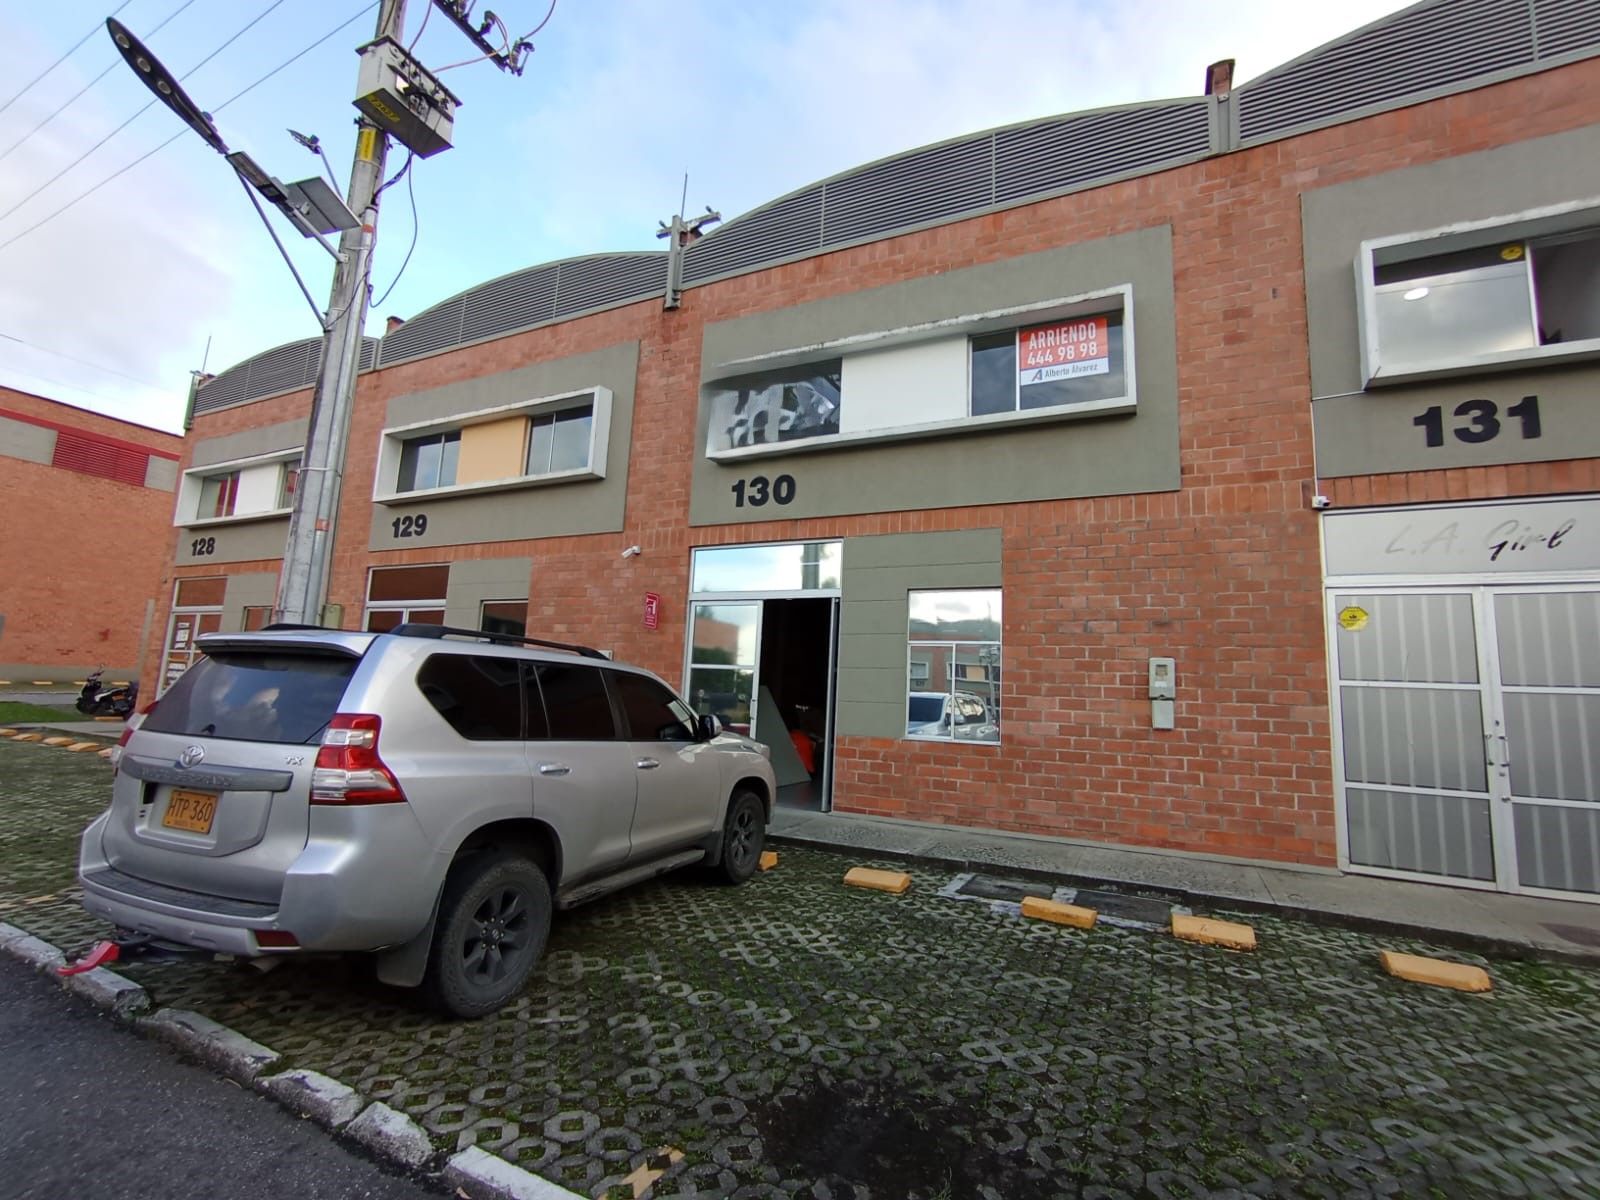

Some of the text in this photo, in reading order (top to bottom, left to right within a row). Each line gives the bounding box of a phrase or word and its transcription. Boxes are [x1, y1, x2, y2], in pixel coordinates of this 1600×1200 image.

[1028, 322, 1096, 349] ARRIENDO
[1027, 341, 1098, 365] 444 98 98
[1044, 368, 1070, 378] Alberto
[1412, 395, 1541, 448] 131
[731, 474, 797, 508] 130
[391, 514, 428, 539] 129
[191, 537, 216, 557] 128
[1385, 518, 1577, 562] L.A. Girl
[285, 755, 304, 766] TX
[168, 798, 214, 823] HTP 360
